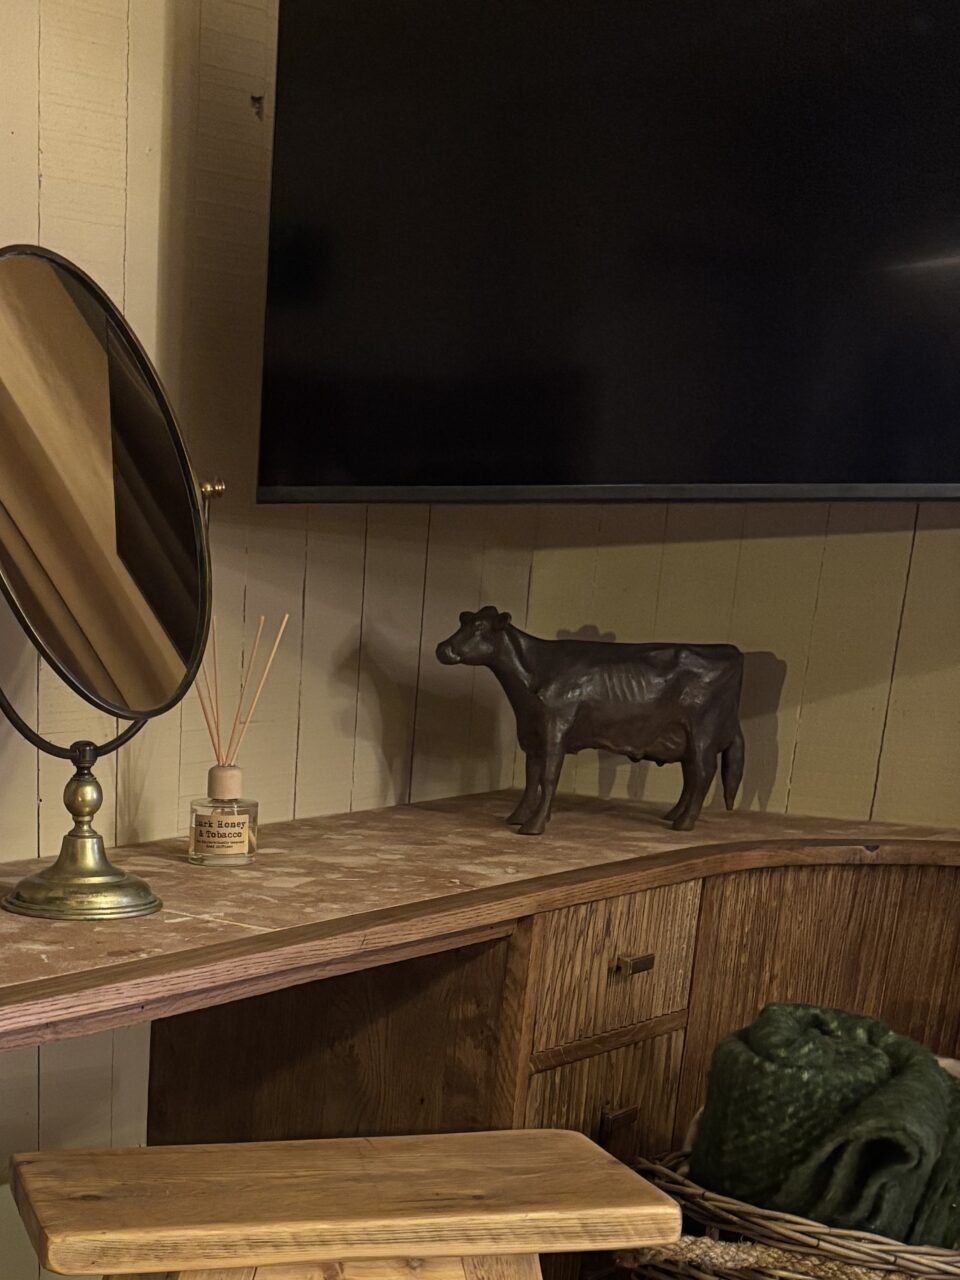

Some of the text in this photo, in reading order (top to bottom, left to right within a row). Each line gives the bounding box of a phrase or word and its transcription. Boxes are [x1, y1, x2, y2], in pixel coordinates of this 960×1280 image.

[196, 820, 246, 830] ark Honey
[206, 830, 243, 839] Tobacco
